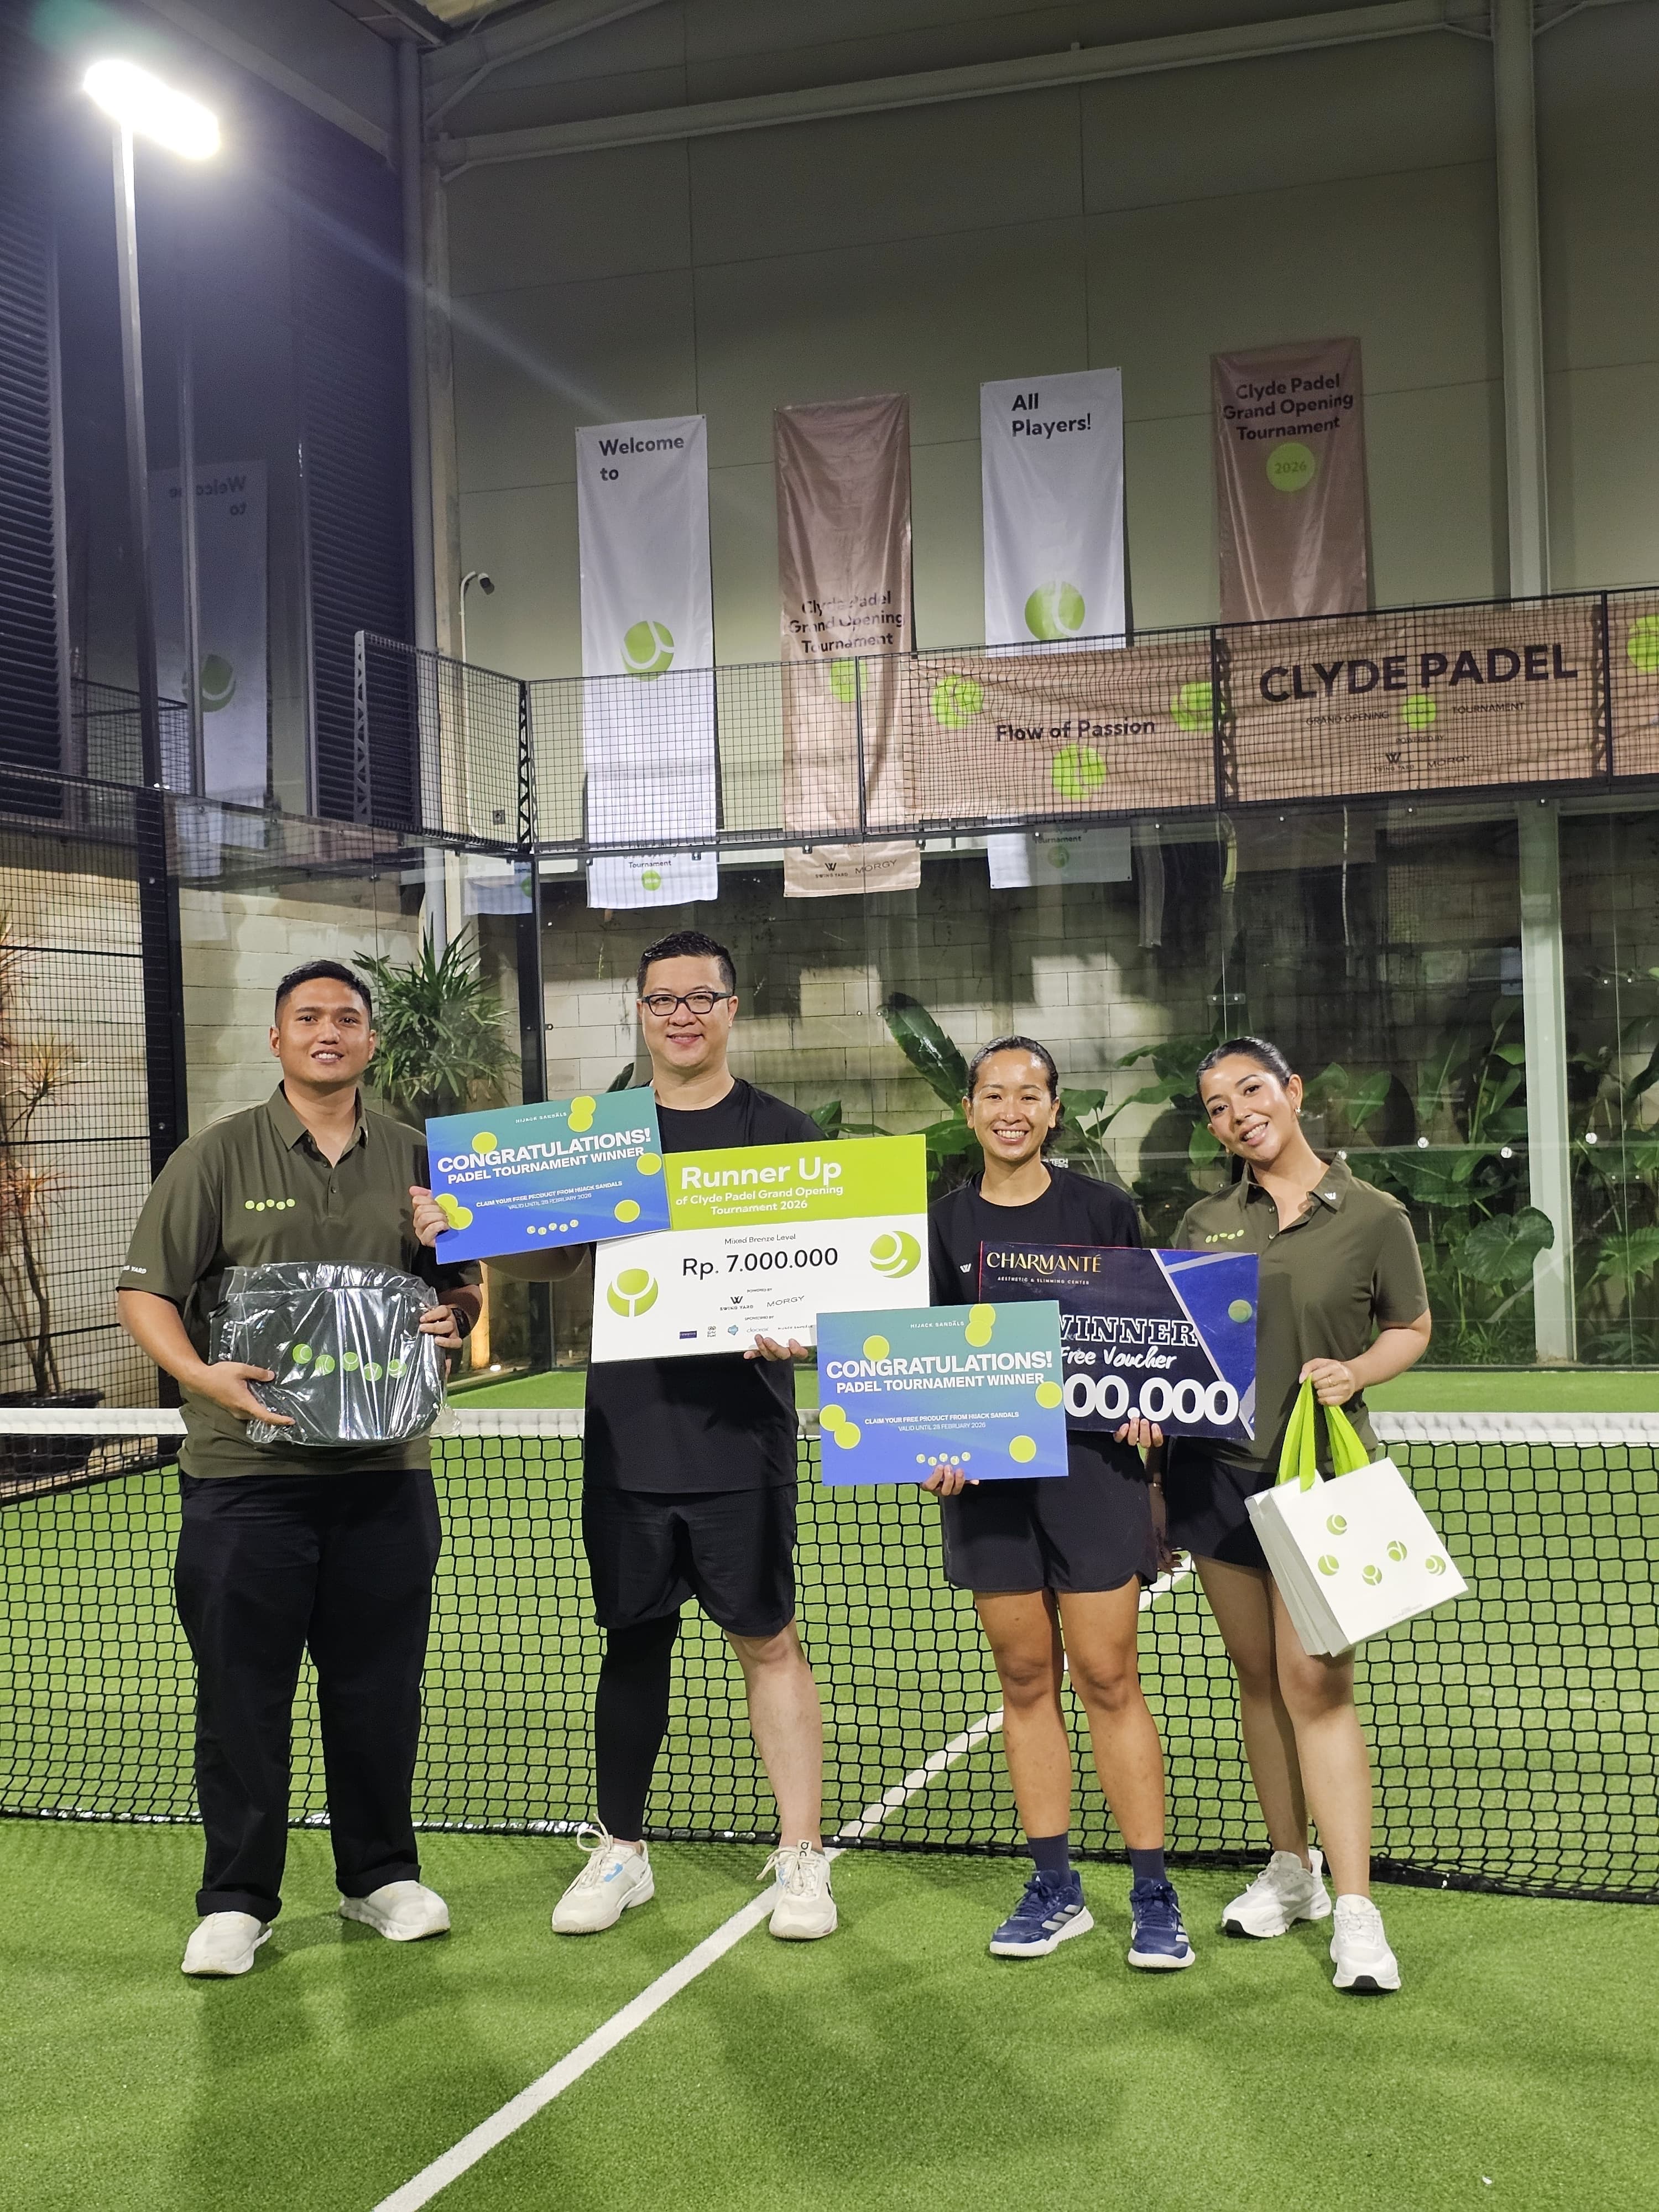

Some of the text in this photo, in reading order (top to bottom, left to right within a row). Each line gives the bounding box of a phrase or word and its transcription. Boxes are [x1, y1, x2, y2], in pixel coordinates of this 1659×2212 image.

[1236, 373, 1340, 401] Clyde Padel
[1011, 393, 1039, 411] All
[1223, 394, 1353, 420] Grand Opening
[1012, 413, 1091, 439] Players!
[1237, 417, 1340, 440] Tournament
[599, 436, 684, 457] Welcome
[600, 467, 619, 481] to
[1274, 461, 1307, 474] 2026
[1259, 644, 1578, 702] CLYDE PADEL
[1306, 702, 1525, 726] GRAND OPENING TOURNAMENT
[997, 718, 1155, 742] Flow of Passion
[628, 860, 671, 868] Tournament
[855, 859, 898, 874] MORGY
[437, 1128, 651, 1173] CONGRATULATIONS!
[448, 1147, 645, 1184] PADEL TOURNAMENT WINNER
[681, 1156, 842, 1190] Runner Up
[596, 1181, 623, 1190] SANDALS
[676, 1185, 843, 1206] of Clyde Padel Grand Opening
[711, 1199, 808, 1215] Tournament 2026
[724, 1237, 747, 1245] Mixed
[682, 1248, 838, 1280] Rp. 7.000.000
[987, 1252, 1102, 1275] CHARMANTÉ
[766, 1295, 805, 1308] MORGY
[826, 1351, 1052, 1379] CONGRATULATIONS!
[1103, 1345, 1177, 1369] Voucher
[836, 1373, 1045, 1394] PADEL TOURNAMENT WINNER
